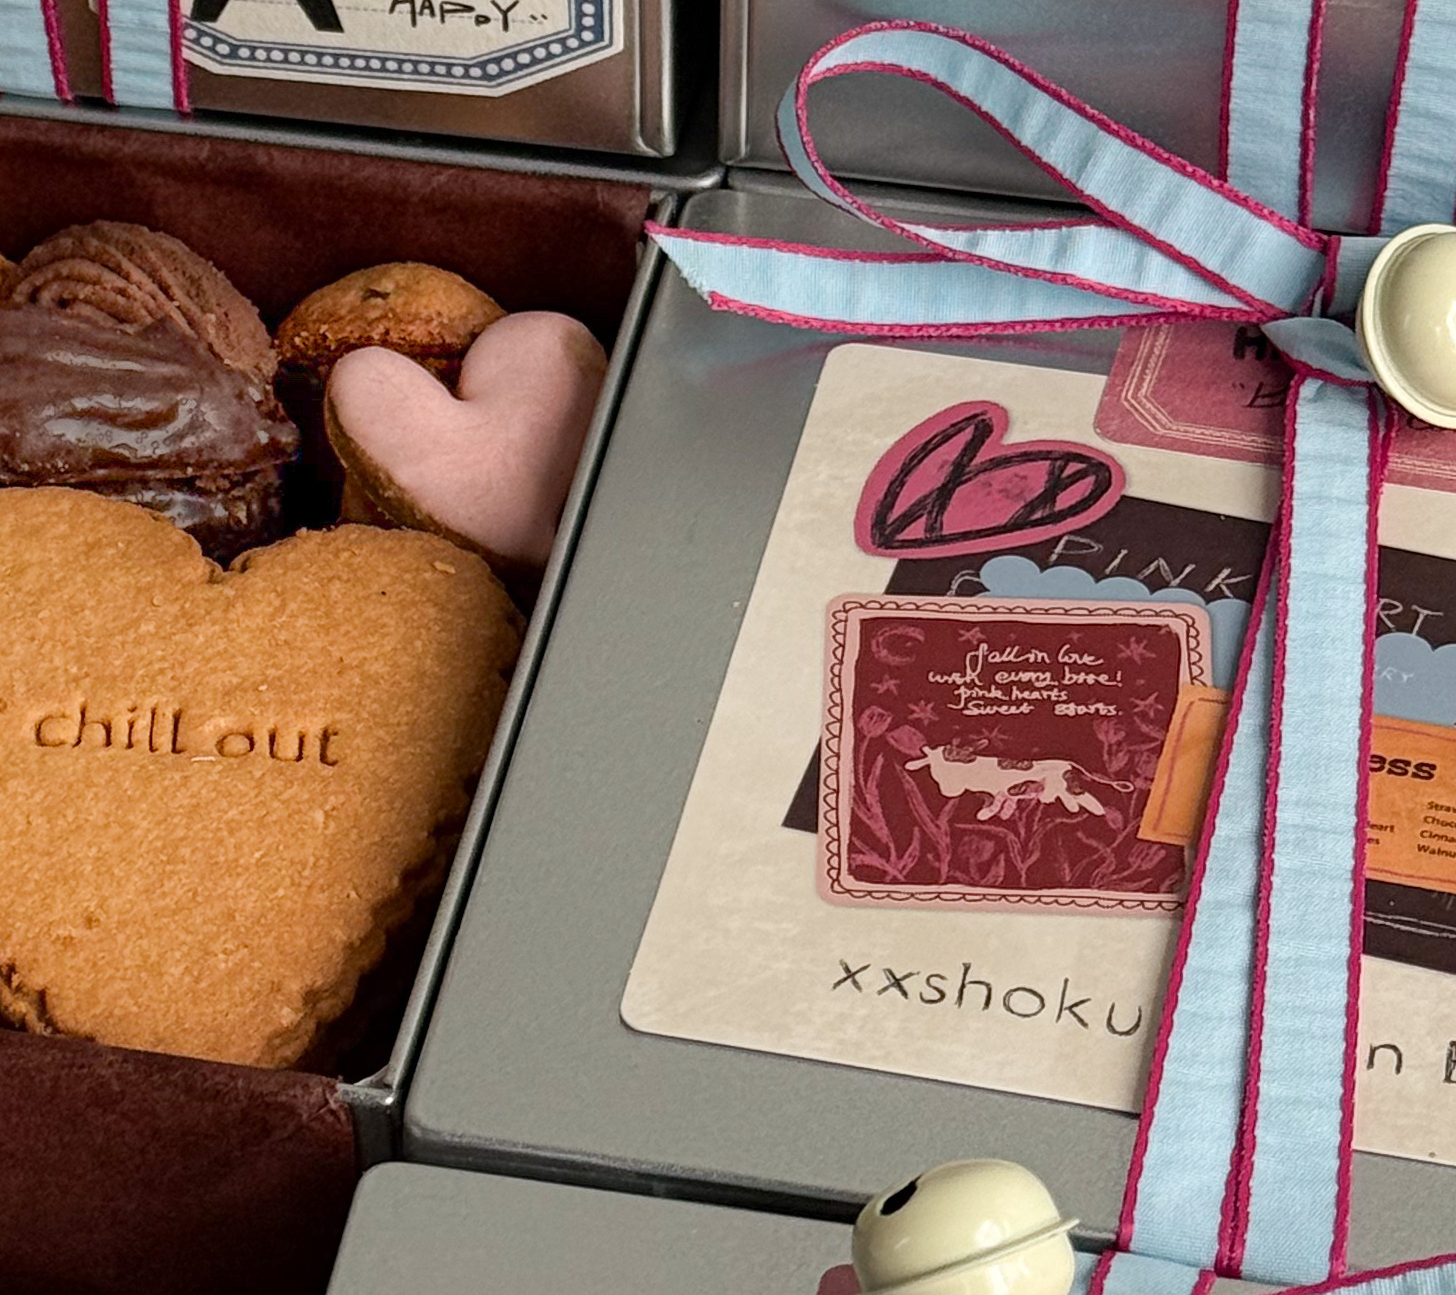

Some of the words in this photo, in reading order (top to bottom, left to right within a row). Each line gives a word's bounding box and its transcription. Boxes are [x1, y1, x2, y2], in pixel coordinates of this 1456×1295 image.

[1049, 534, 1254, 599] PINK
[34, 706, 188, 755] chill
[214, 724, 340, 767] out
[831, 959, 1142, 1037] xxshoku
